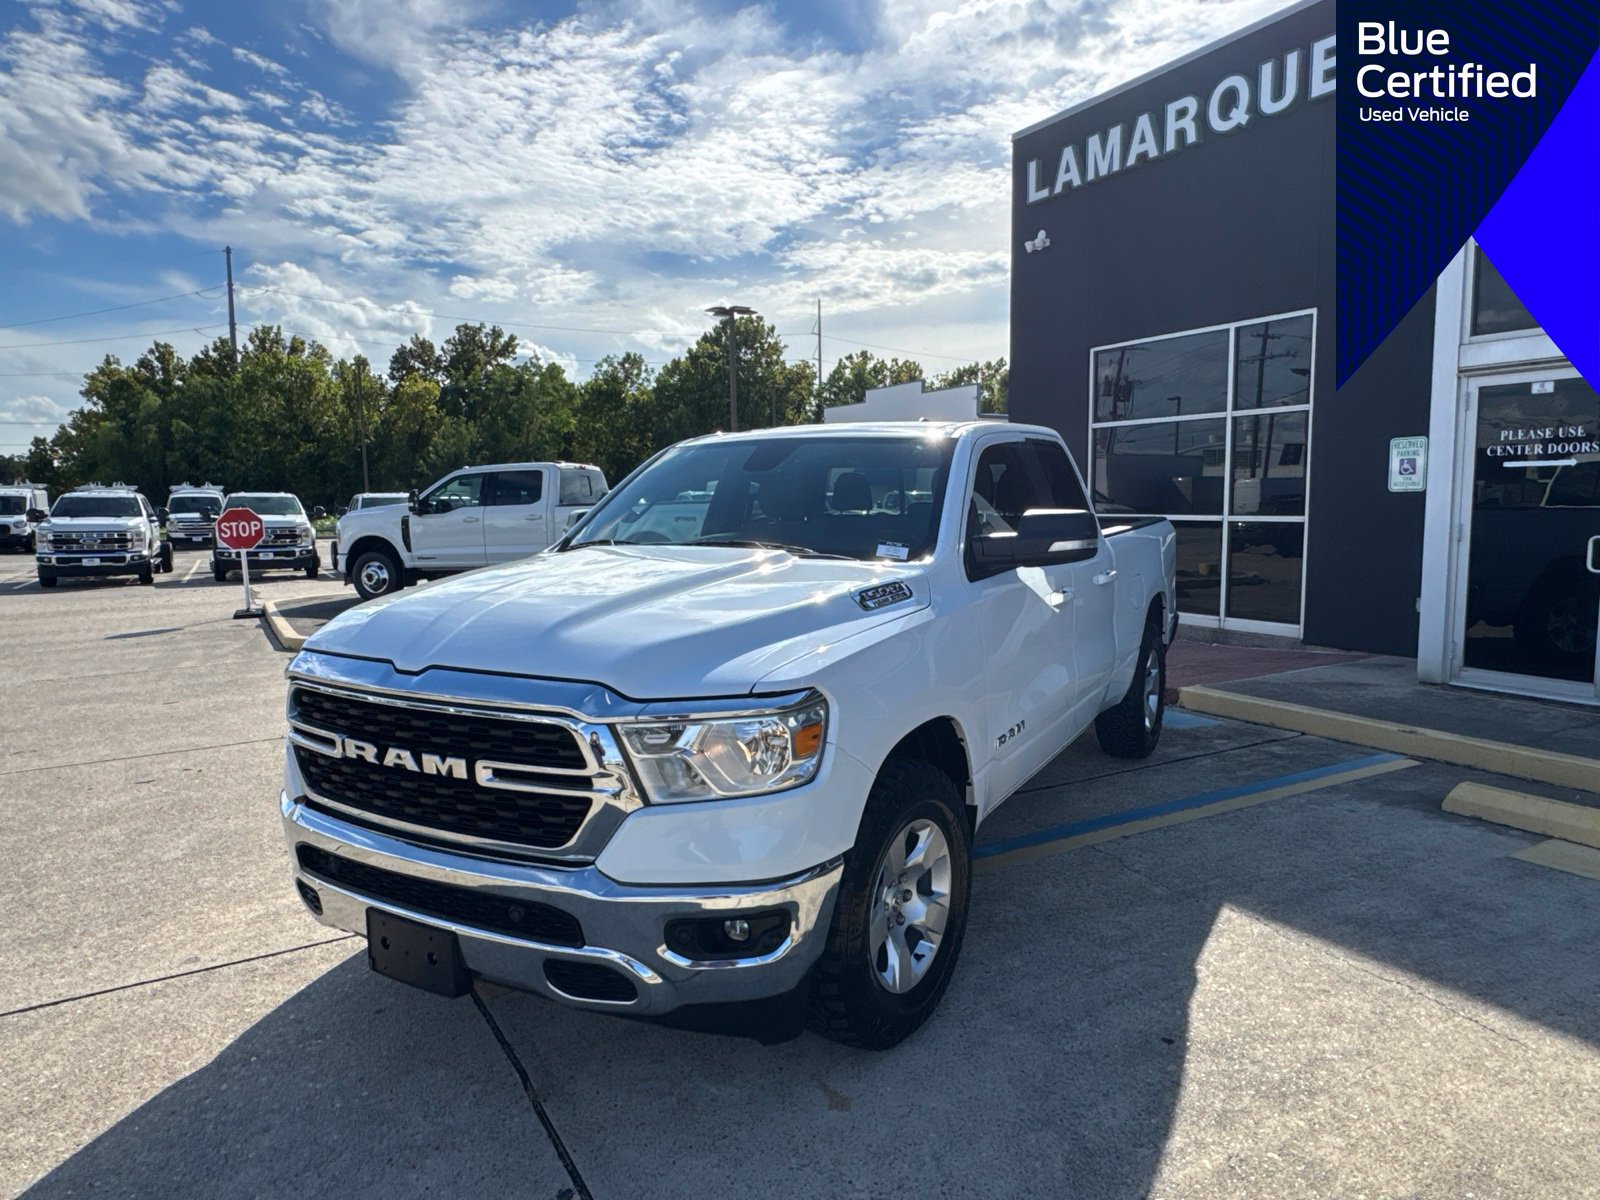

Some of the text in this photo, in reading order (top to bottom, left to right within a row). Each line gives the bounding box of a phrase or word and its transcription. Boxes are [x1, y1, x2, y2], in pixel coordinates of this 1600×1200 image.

[1026, 34, 1336, 205] LAMARQUE
[1500, 425, 1586, 441] PLEASE USE
[1486, 441, 1600, 456] CENTER DOORS
[220, 521, 261, 538] STOP
[344, 738, 468, 779] RAM
